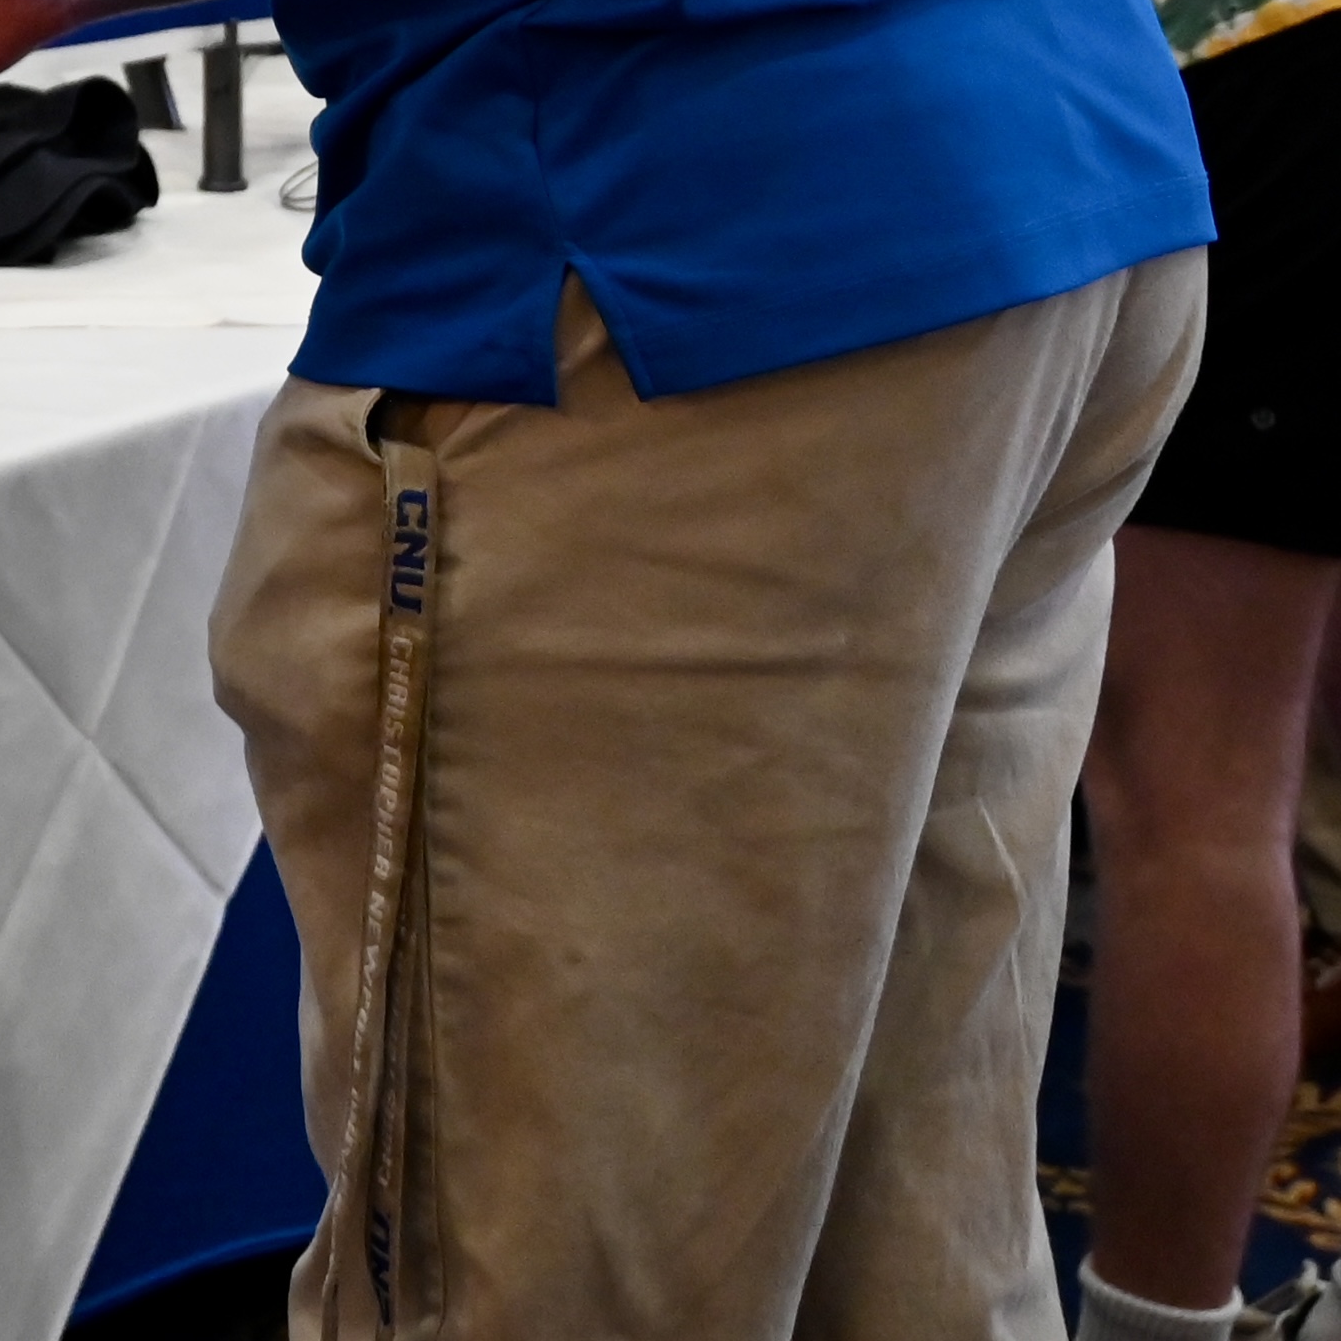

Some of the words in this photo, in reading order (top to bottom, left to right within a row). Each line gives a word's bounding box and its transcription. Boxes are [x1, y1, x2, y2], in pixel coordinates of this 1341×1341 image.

[389, 488, 429, 616] CNU
[372, 634, 415, 880] CHRISTOPHER
[351, 889, 387, 1075] NEWPORT
